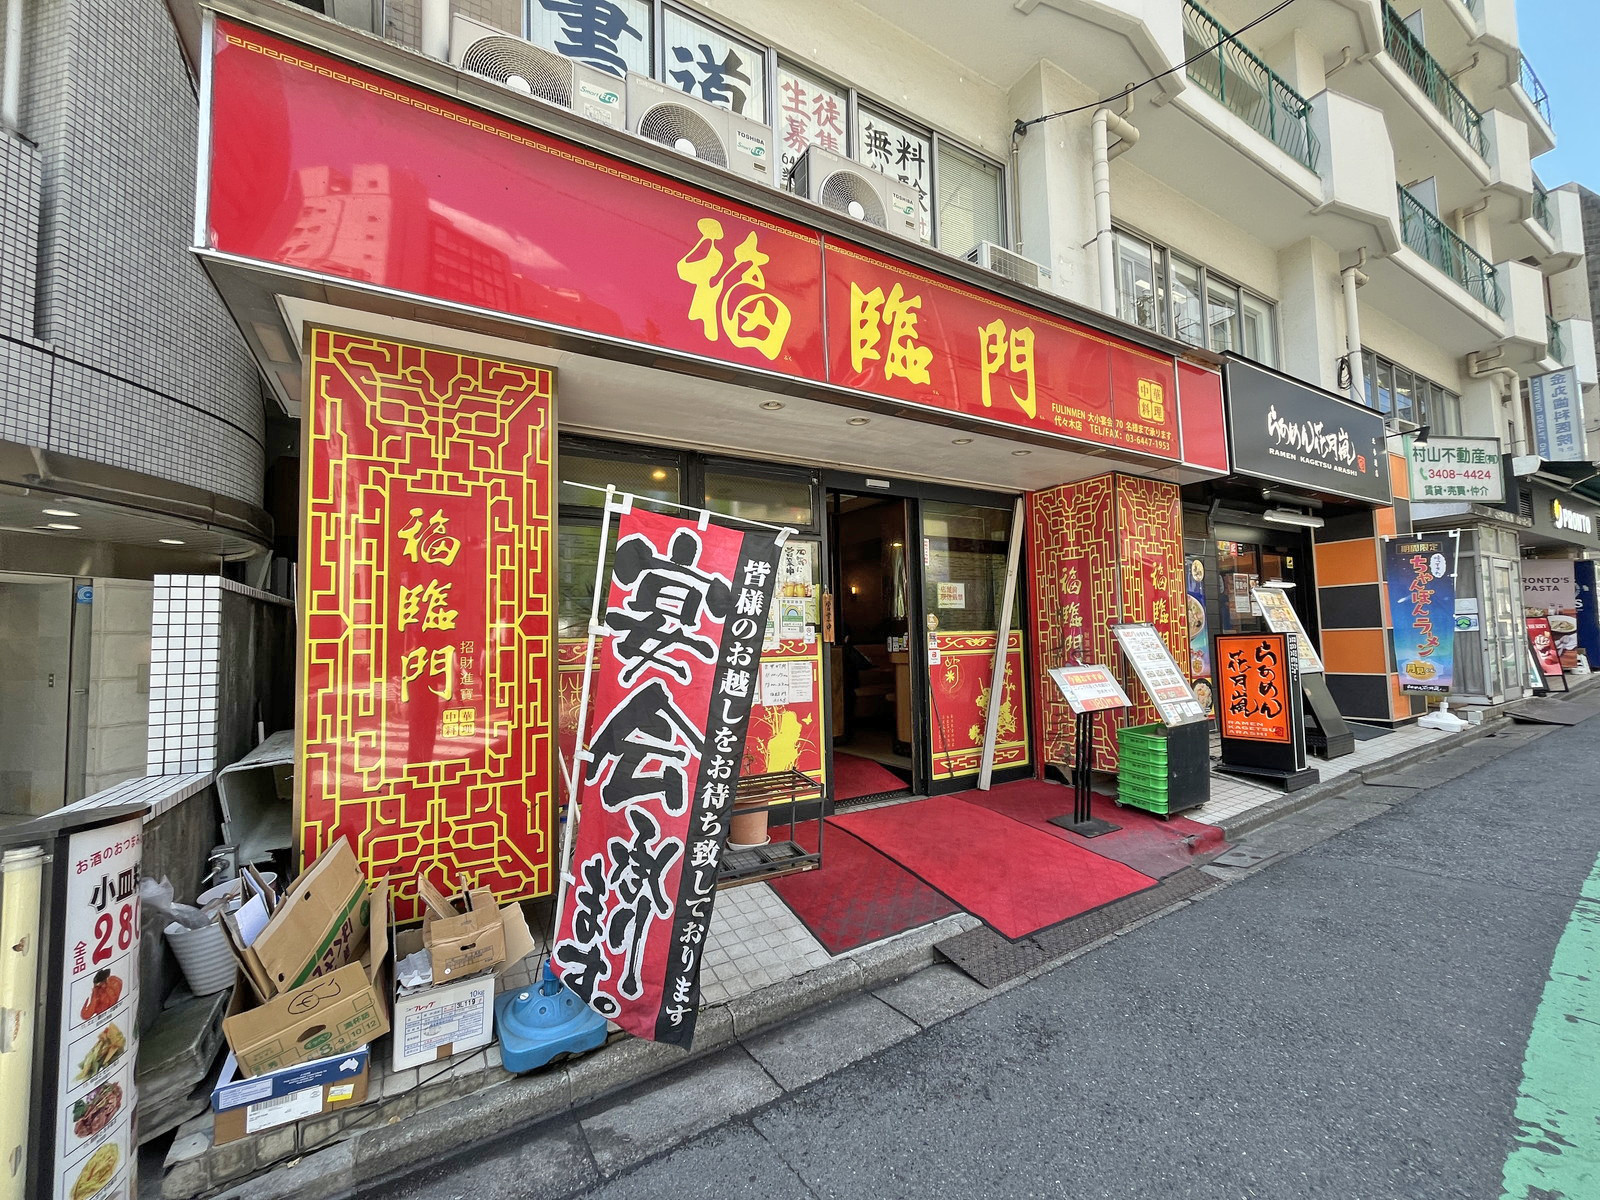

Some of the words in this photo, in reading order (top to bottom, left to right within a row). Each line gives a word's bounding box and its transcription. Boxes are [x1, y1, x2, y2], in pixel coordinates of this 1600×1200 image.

[781, 79, 843, 136] 生徒
[737, 130, 765, 146] TOSHIBA
[864, 121, 926, 181] 無料
[676, 216, 1037, 421] 福臨門
[1138, 379, 1163, 403] 中華
[1051, 402, 1086, 420] FULINMEN
[1087, 412, 1114, 428] 大小宴会
[1115, 419, 1124, 429] 70
[1139, 399, 1164, 422] 料理
[1054, 415, 1083, 432] 代々木店
[1125, 433, 1171, 451] 03-6447-1953
[1269, 447, 1297, 461] RAMEN
[1300, 455, 1333, 470] KAGETSU
[1333, 464, 1358, 477] ARASHI
[1412, 447, 1499, 465] 村山不動産(有)
[1428, 469, 1491, 480] 3408-4424
[1562, 508, 1592, 535] PRONTO
[1400, 543, 1439, 553] 期間限定
[397, 507, 462, 703] 福臨門
[1409, 554, 1440, 657] ちゃんぽんラーメン
[460, 640, 474, 701] 招財進寶
[1227, 649, 1260, 718] 花月嵐
[1254, 640, 1283, 719] らあめん
[443, 708, 475, 724] 中華
[1228, 725, 1277, 733] KAGETSU
[443, 722, 475, 738] 料理
[1229, 729, 1268, 737] ARASHI
[664, 558, 772, 1027] 皆様のお越しをお待ち致しております
[73, 941, 87, 975] 全品
[352, 1028, 362, 1037] 10
[366, 1020, 377, 1029] 12
